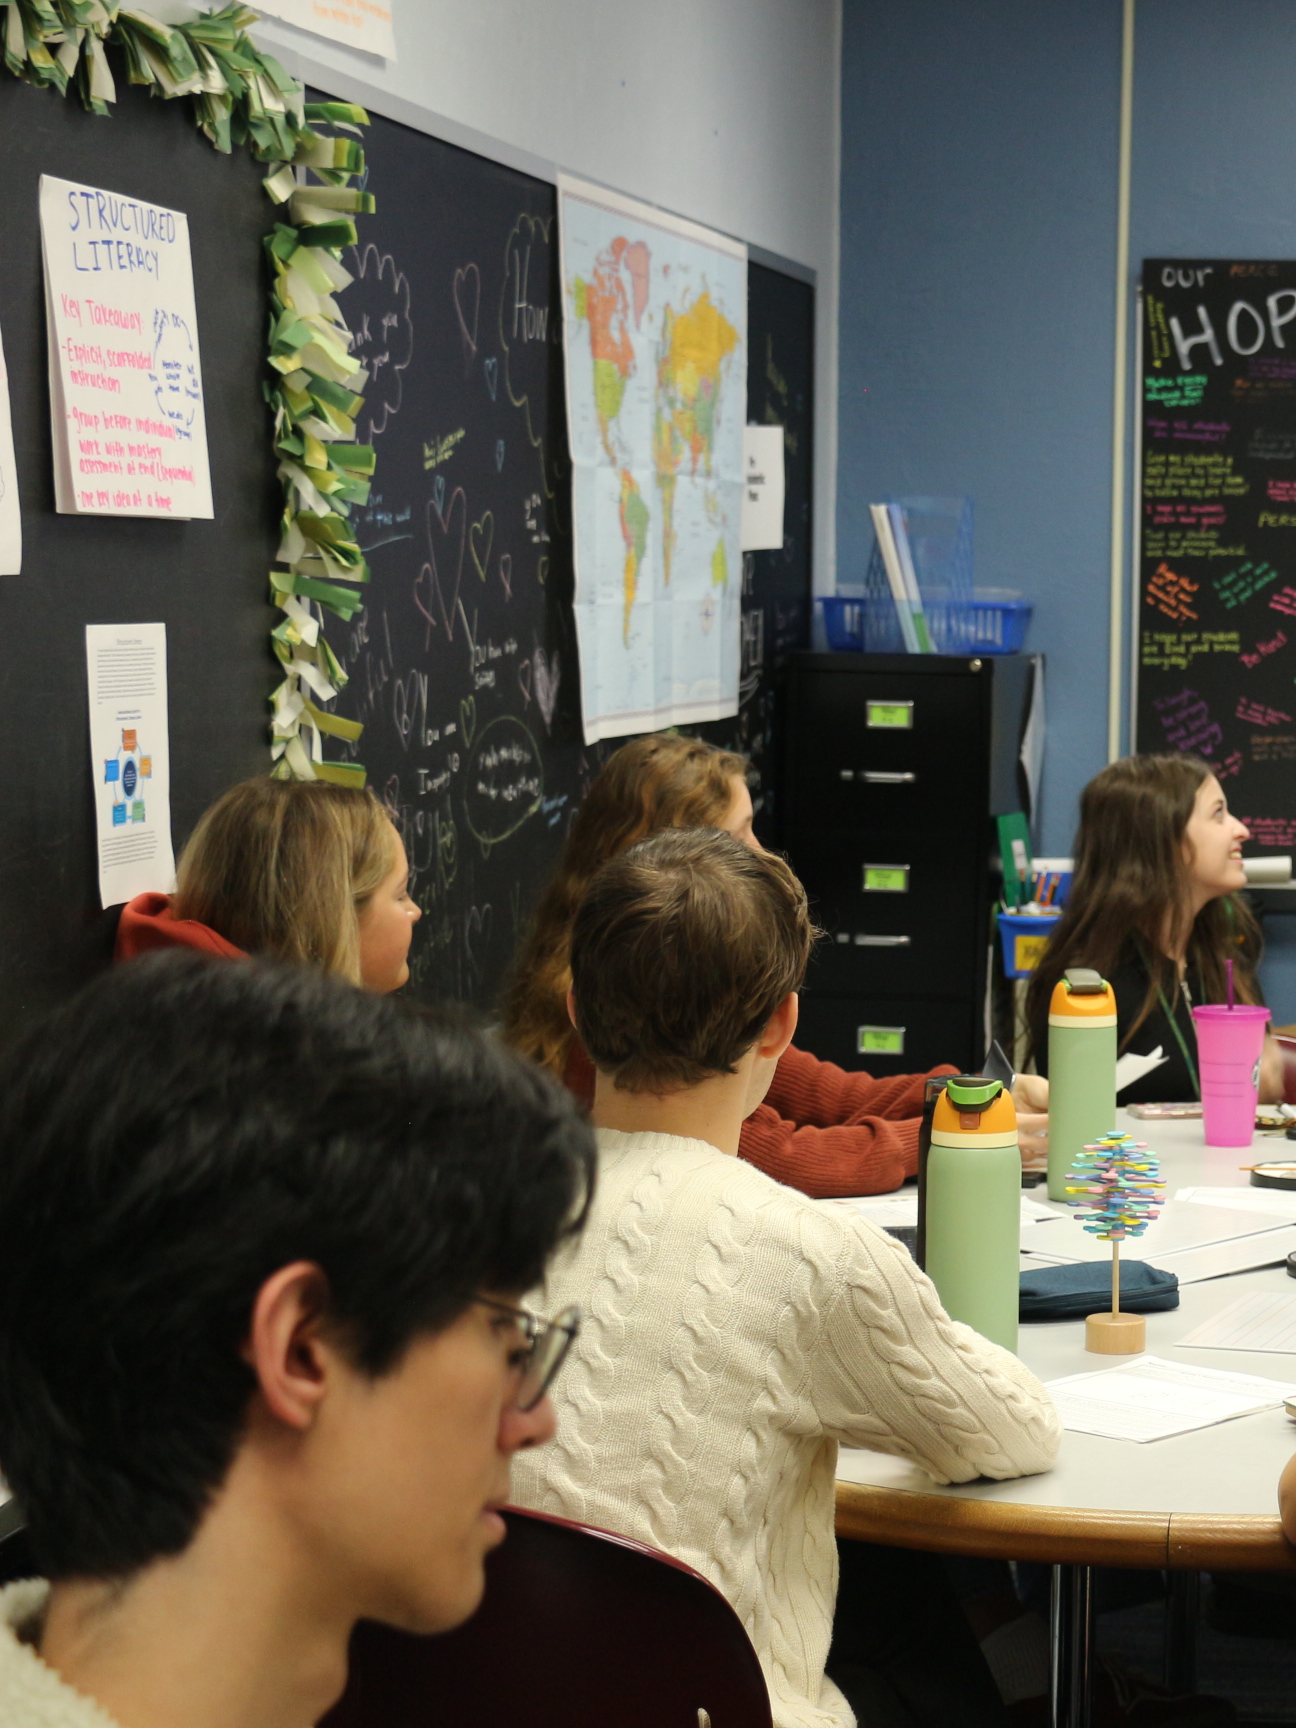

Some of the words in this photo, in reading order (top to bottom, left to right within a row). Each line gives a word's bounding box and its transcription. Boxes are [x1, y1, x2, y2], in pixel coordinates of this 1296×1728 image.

[68, 191, 175, 243] STRUCTURED
[73, 240, 159, 280] LITERACY
[61, 293, 82, 327] Key
[104, 441, 125, 458] with
